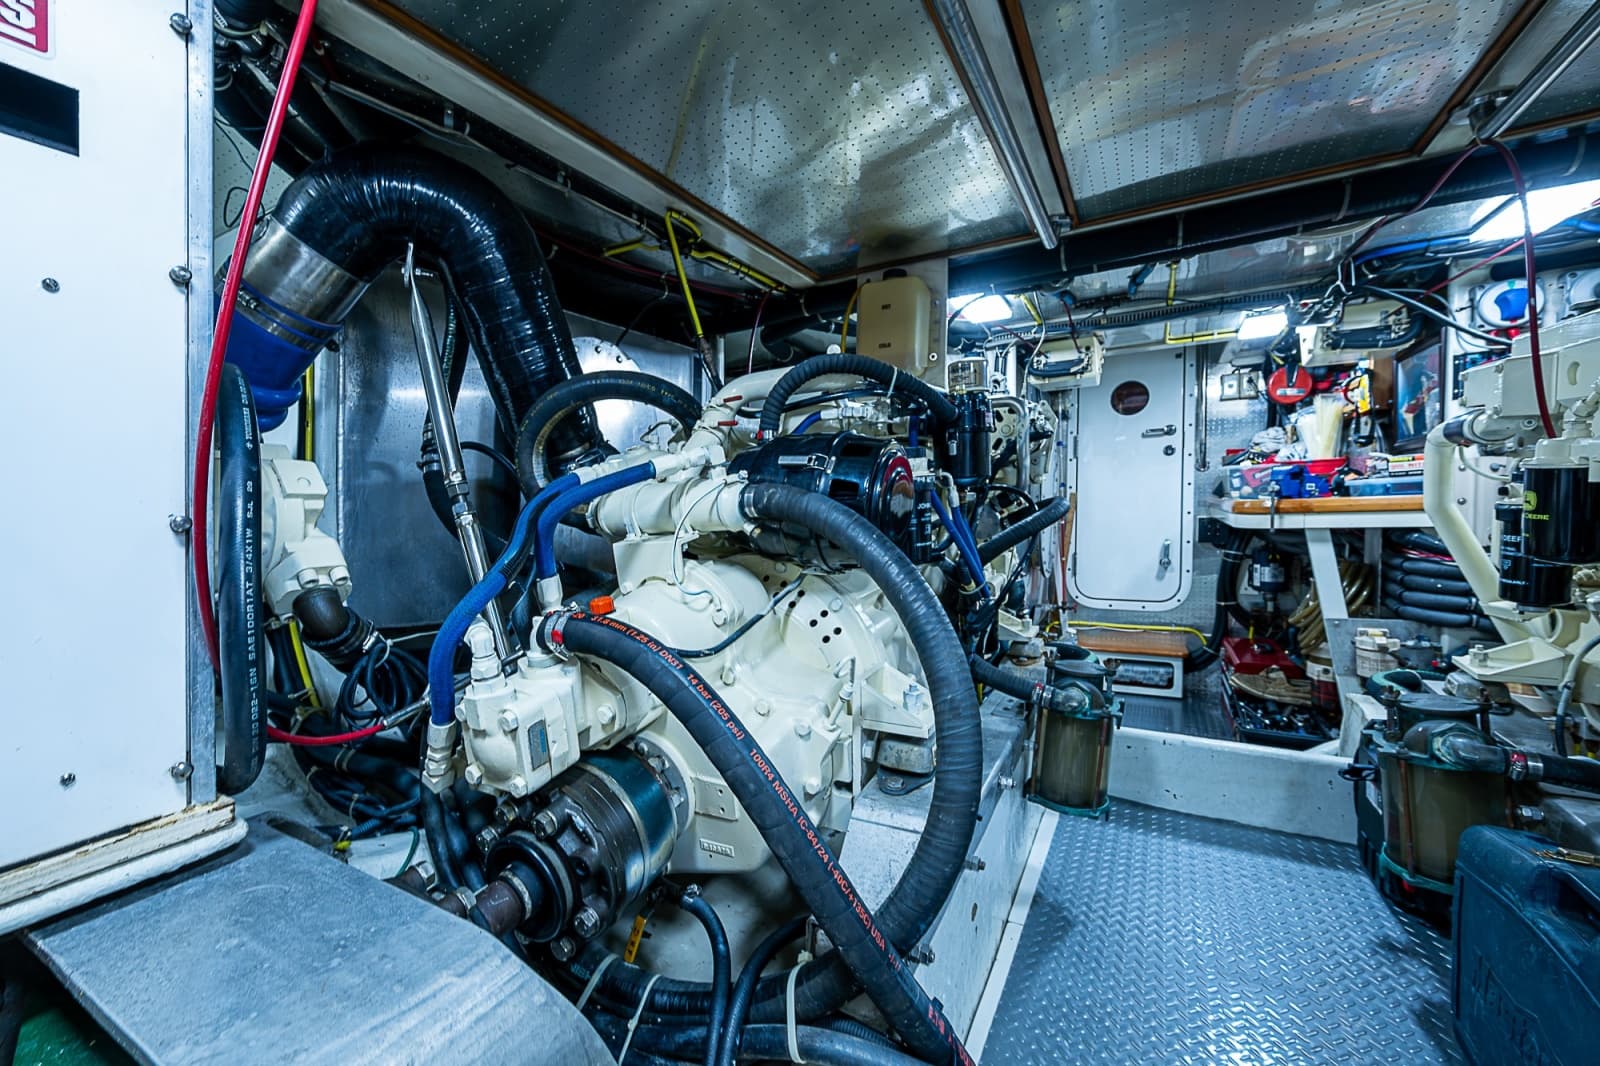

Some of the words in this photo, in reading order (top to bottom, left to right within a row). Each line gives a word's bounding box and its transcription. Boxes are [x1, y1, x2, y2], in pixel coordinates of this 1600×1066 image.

[245, 527, 254, 574] 3/4X1W
[245, 580, 257, 661] SAE100R1AT
[626, 628, 648, 643] (1.25
[647, 641, 661, 652] in)
[660, 650, 684, 670] DN31
[687, 673, 699, 685] 14
[696, 684, 713, 700] bar
[709, 700, 731, 721] (205
[726, 720, 745, 740] psi)
[749, 748, 775, 781] 100R4
[772, 780, 798, 817] MSHA
[870, 925, 886, 952] USA
